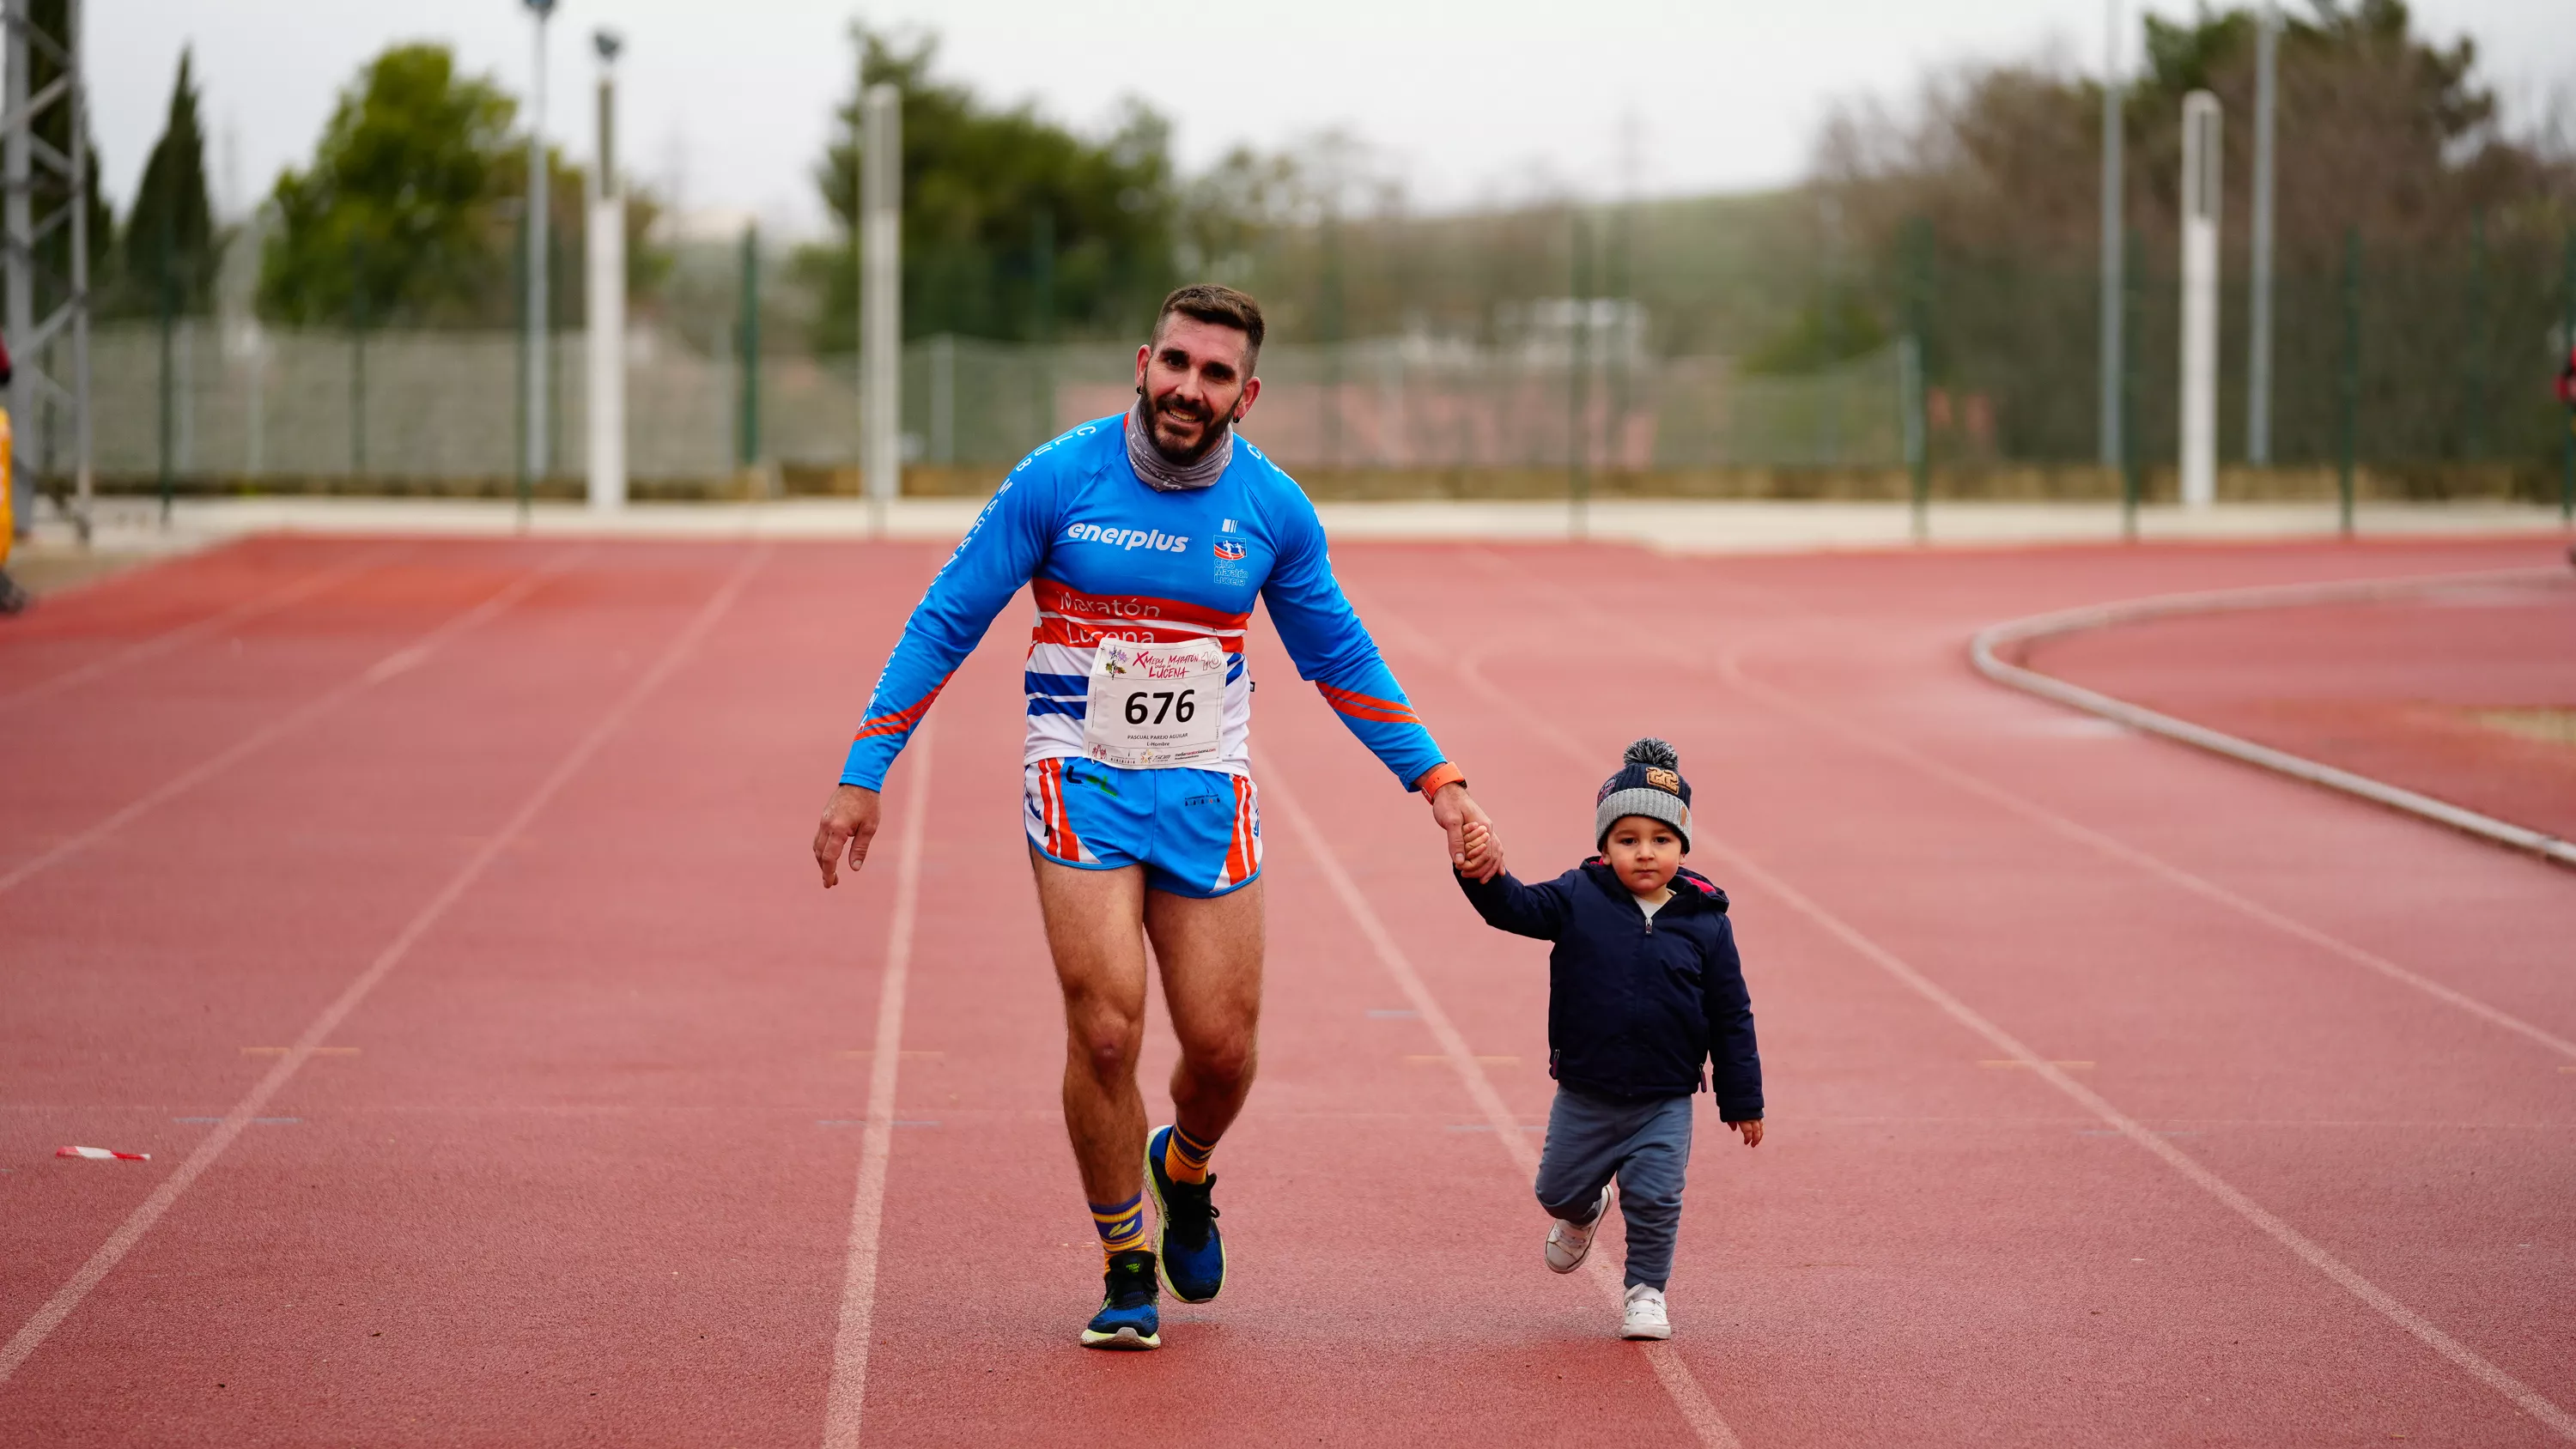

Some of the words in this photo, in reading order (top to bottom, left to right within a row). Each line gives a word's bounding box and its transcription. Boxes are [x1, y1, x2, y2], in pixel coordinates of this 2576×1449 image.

[1016, 426, 1097, 471] CLUB
[1067, 522, 1189, 553] enerplus
[1214, 559, 1235, 569] Club
[1214, 567, 1249, 579] Maratón
[1214, 574, 1246, 585] Lucena
[1057, 591, 1160, 617] Maratón
[1149, 666, 1190, 678] LUCENA
[1125, 689, 1195, 724] 676
